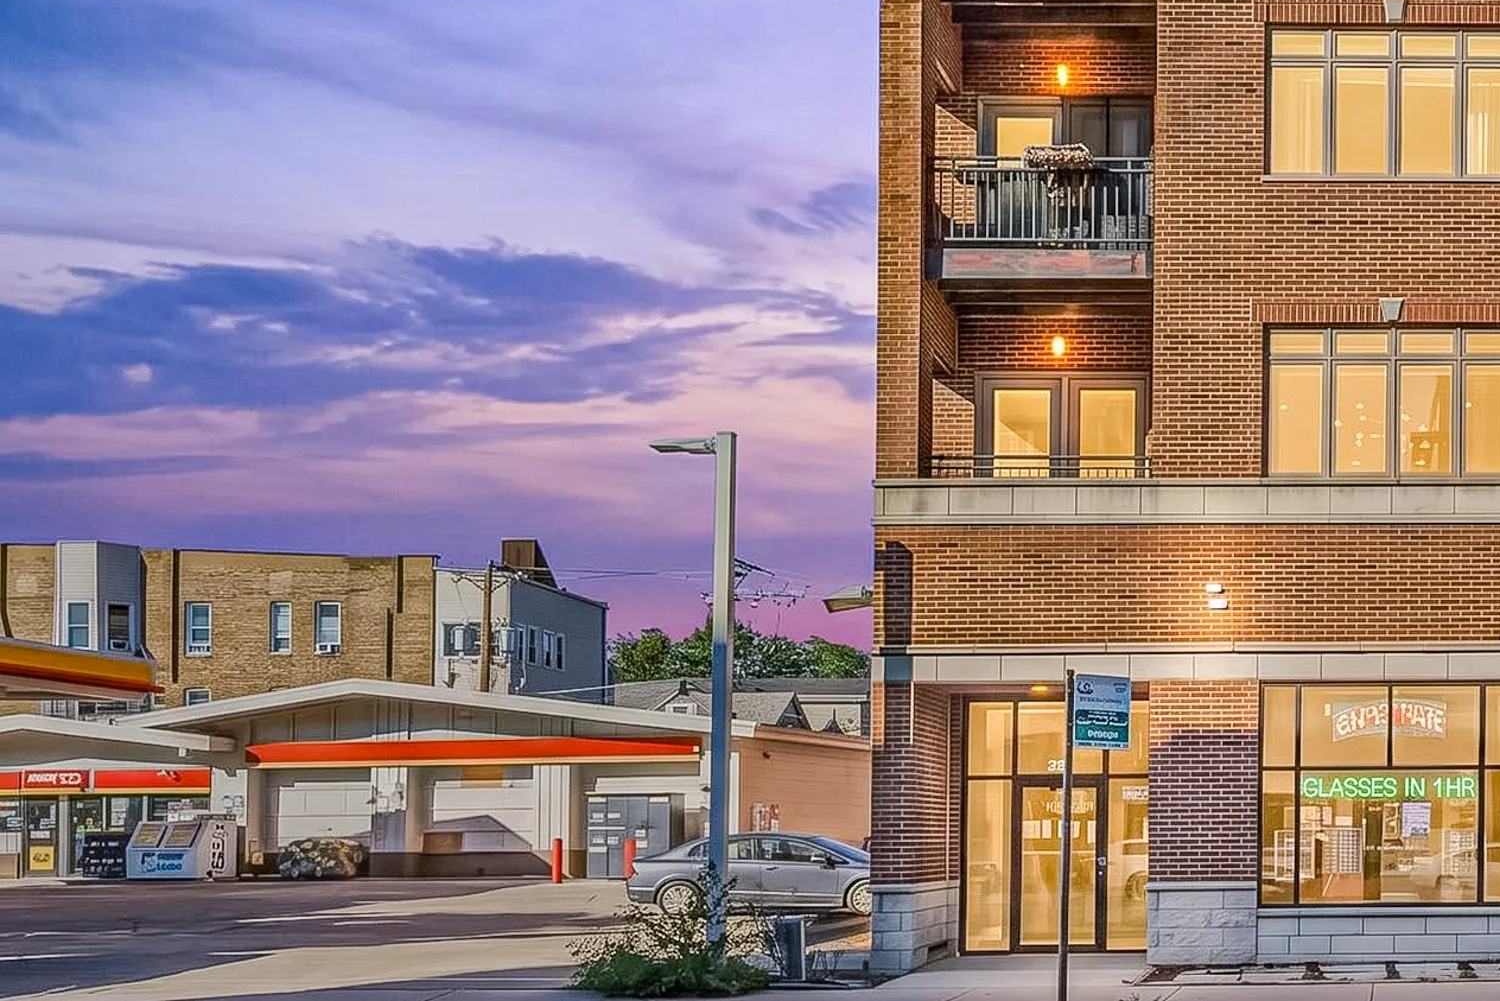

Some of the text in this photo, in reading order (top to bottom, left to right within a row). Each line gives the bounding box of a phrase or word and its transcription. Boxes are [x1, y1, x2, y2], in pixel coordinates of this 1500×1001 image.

[1303, 776, 1476, 798] GLASSES IN 1HR
